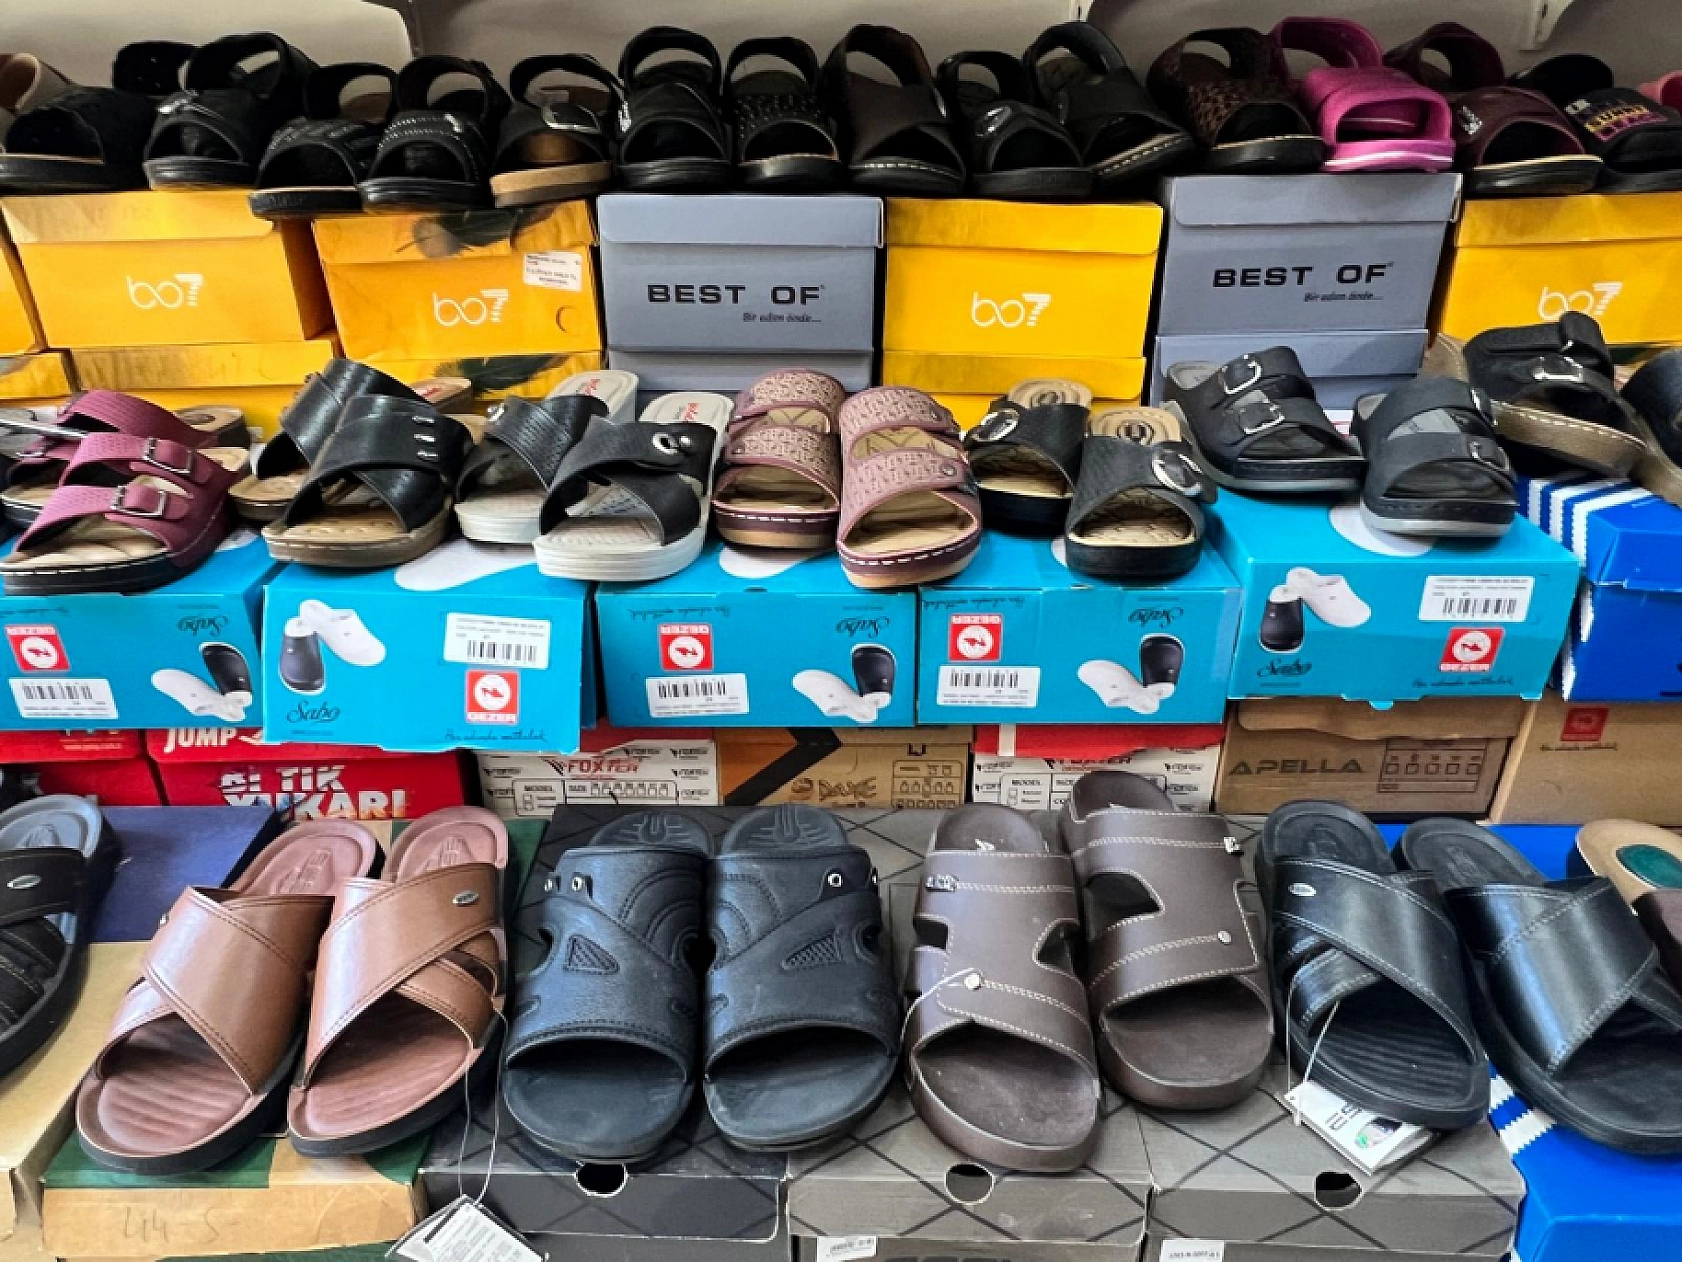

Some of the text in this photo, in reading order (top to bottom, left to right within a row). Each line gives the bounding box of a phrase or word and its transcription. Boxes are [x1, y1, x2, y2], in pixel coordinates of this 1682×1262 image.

[1212, 264, 1388, 287] BEST OF
[647, 284, 821, 305] BEST OF
[163, 728, 238, 754] JUMP
[1229, 758, 1366, 776] APELLA
